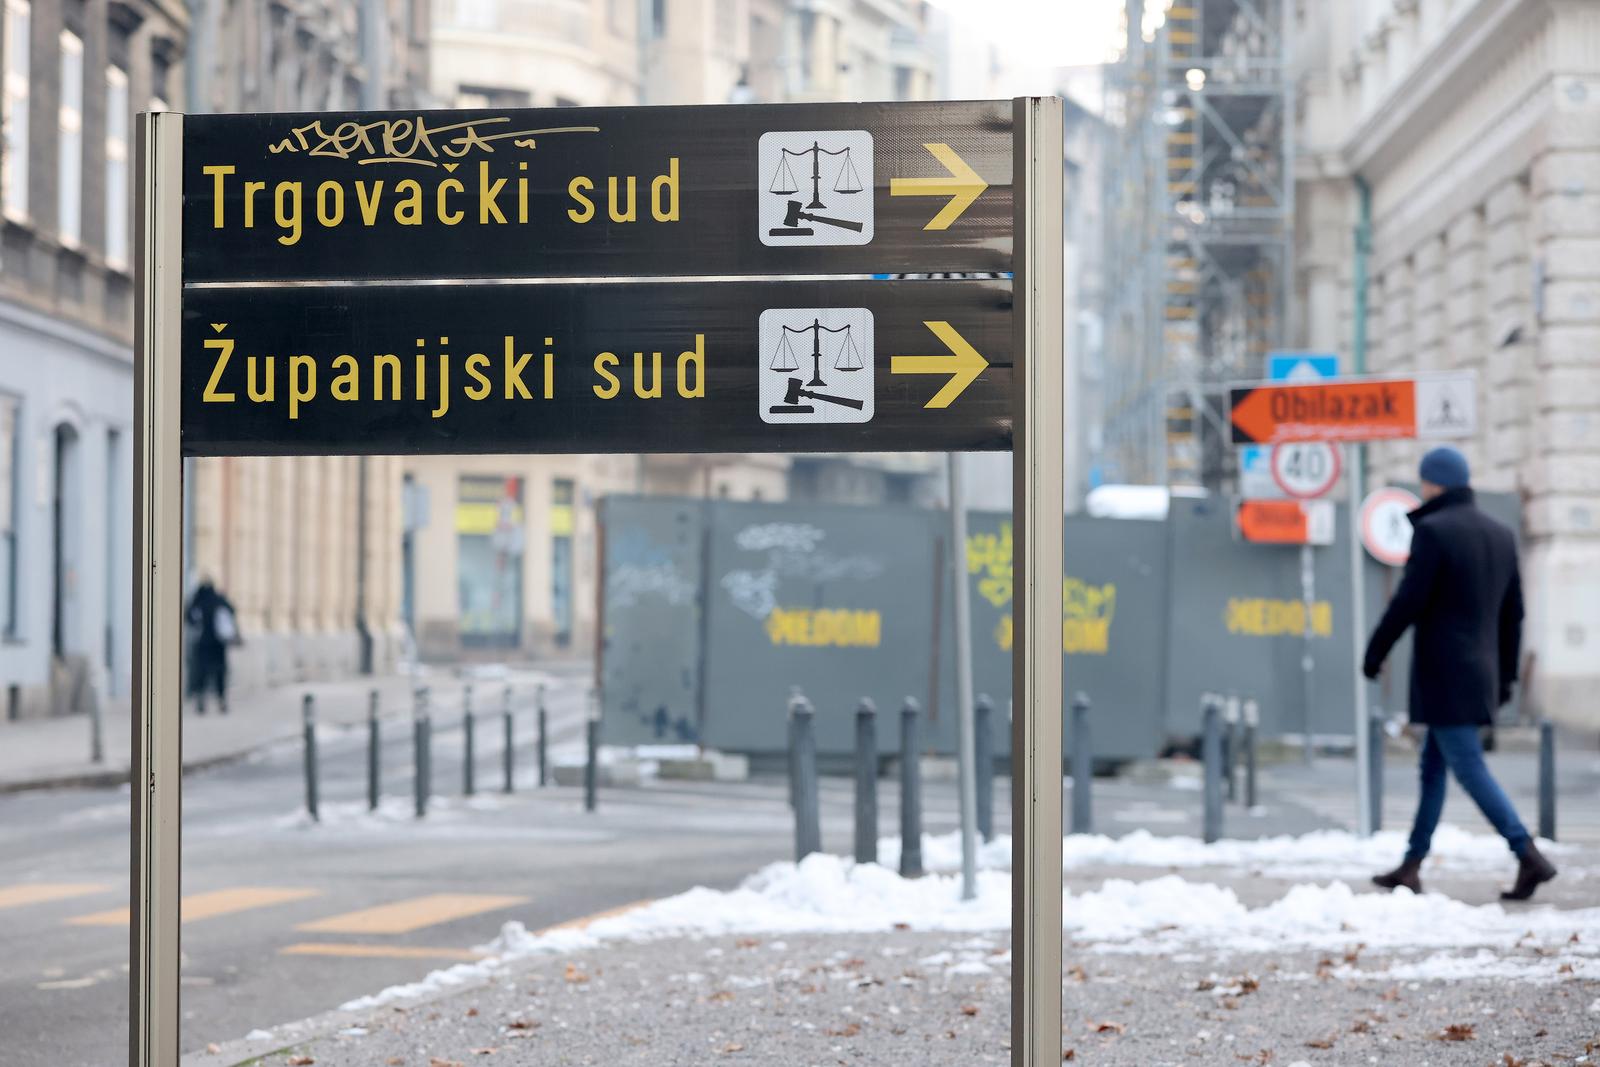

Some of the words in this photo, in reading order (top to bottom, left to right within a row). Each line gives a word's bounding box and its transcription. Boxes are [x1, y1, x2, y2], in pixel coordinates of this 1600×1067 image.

[202, 160, 529, 246] Trgovački
[567, 157, 680, 224] sud
[202, 323, 554, 419] Županijski
[592, 333, 705, 400] sud
[1271, 384, 1398, 423] Obilazak
[1285, 446, 1326, 480] 40
